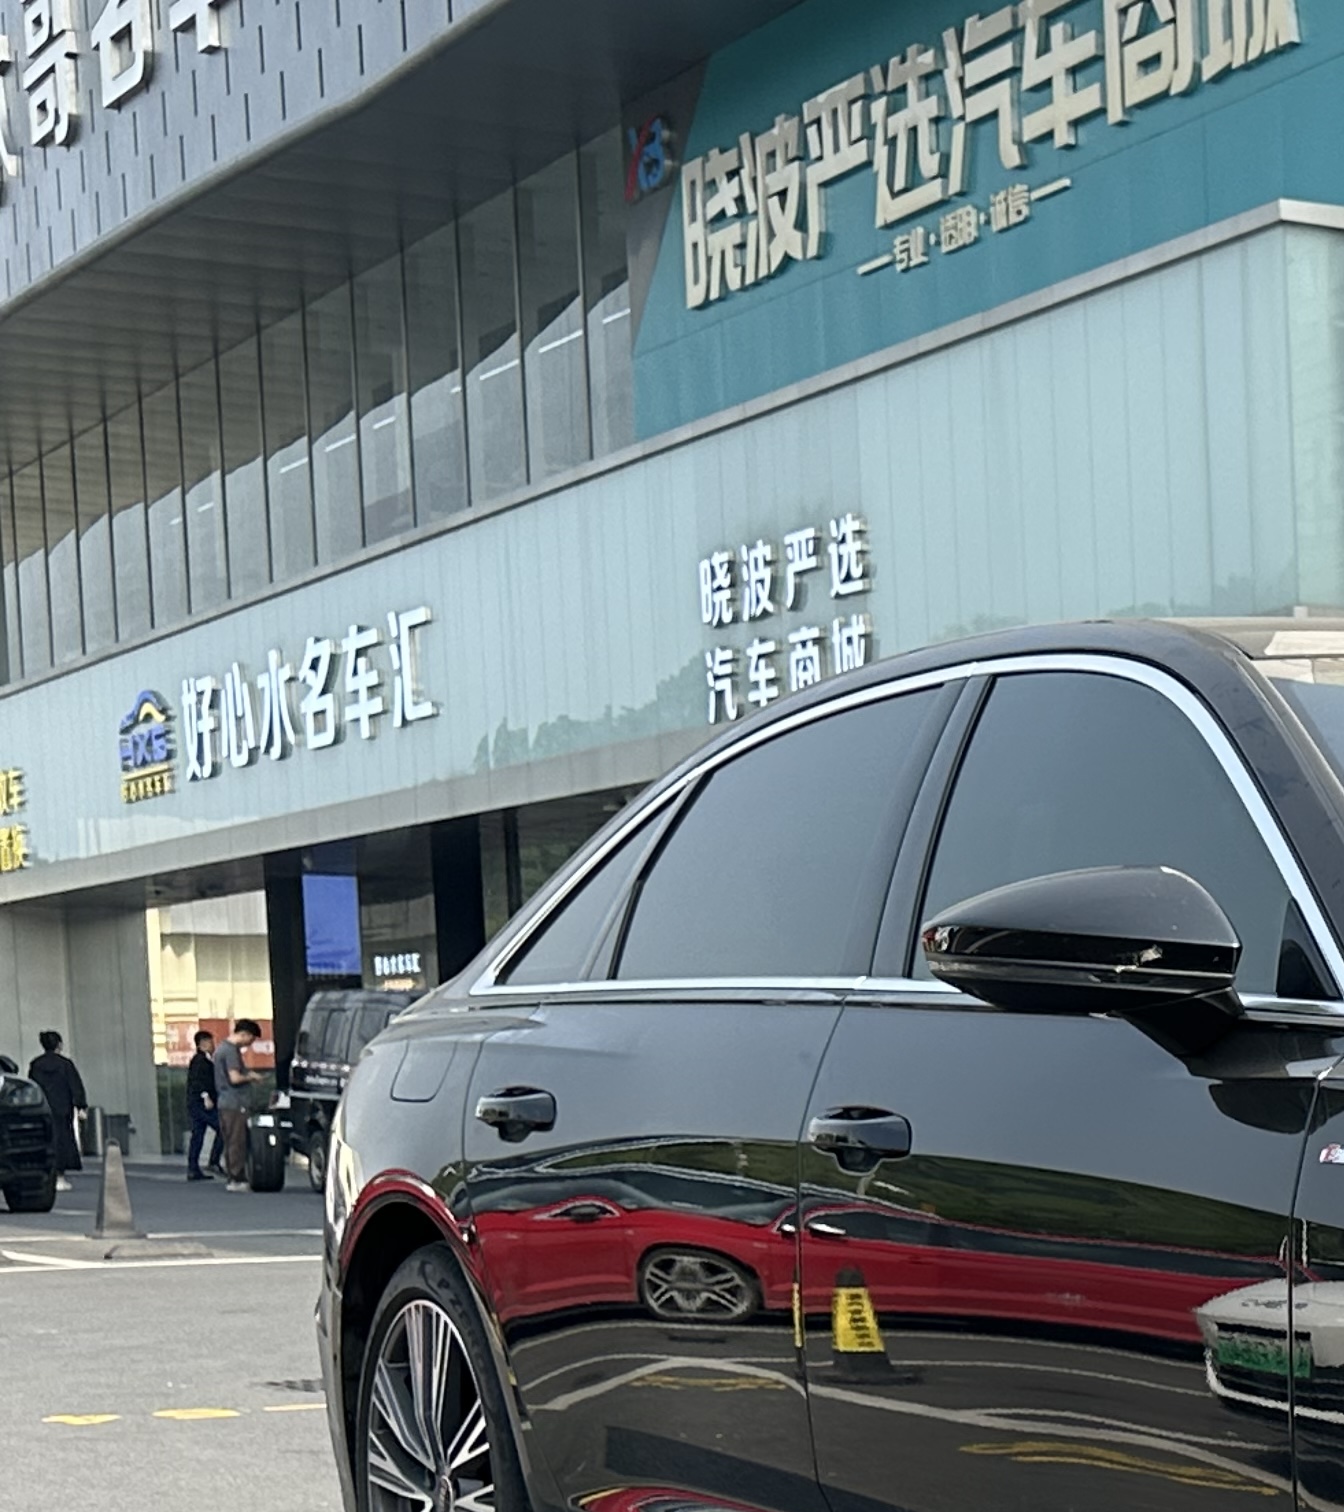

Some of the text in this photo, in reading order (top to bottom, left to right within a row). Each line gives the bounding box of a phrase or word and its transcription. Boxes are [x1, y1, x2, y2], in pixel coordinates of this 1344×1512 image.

[0, 0, 221, 176] 哥名
[699, 513, 864, 627] 晓波严选
[182, 606, 434, 781] 好心水名车汇
[705, 614, 866, 724] 汽车商城
